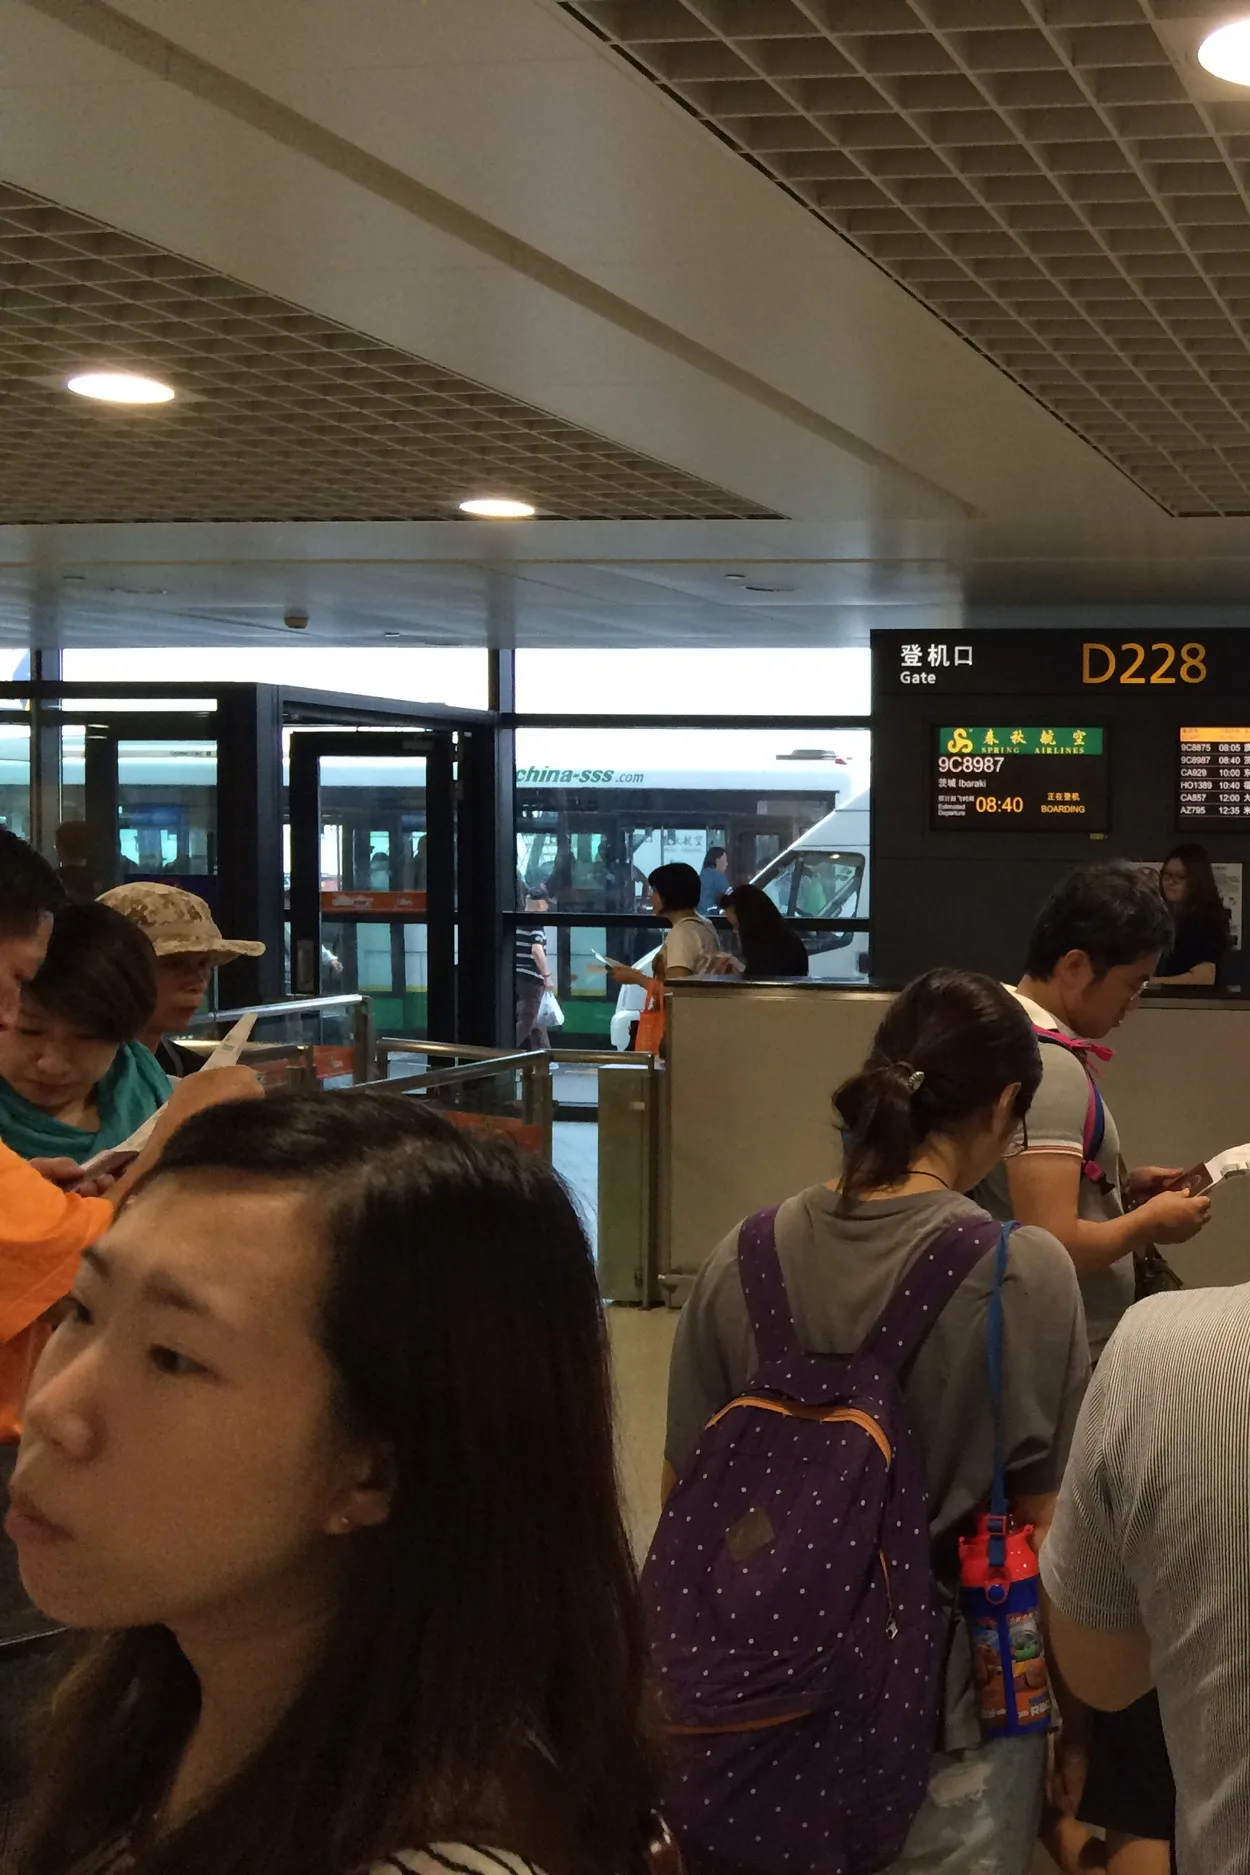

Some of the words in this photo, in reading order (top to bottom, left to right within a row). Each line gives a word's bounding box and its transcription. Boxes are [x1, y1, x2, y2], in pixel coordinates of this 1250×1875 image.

[900, 643, 973, 667] 登机口
[1082, 642, 1207, 684] D228
[900, 671, 937, 684] Gate
[983, 727, 1087, 746] 春秋航空
[981, 746, 1020, 754] SPRING
[1034, 746, 1085, 754] AIRLINES
[1218, 743, 1241, 752] 08:05
[938, 756, 1005, 773] 9C8987
[1180, 756, 1211, 765] 9C8987
[1218, 756, 1241, 765] 08:40
[1218, 768, 1241, 777] 10:00
[938, 777, 957, 788] 茨城
[958, 778, 987, 788] Ibaraki
[1218, 781, 1241, 790] 10:40
[1047, 792, 1080, 801] 正在登机
[1218, 794, 1241, 802] 12:00
[975, 796, 1024, 813] 08:40
[1040, 805, 1086, 814] BOARDING
[1180, 806, 1206, 815] AZ795
[1218, 806, 1241, 815] 12:35
